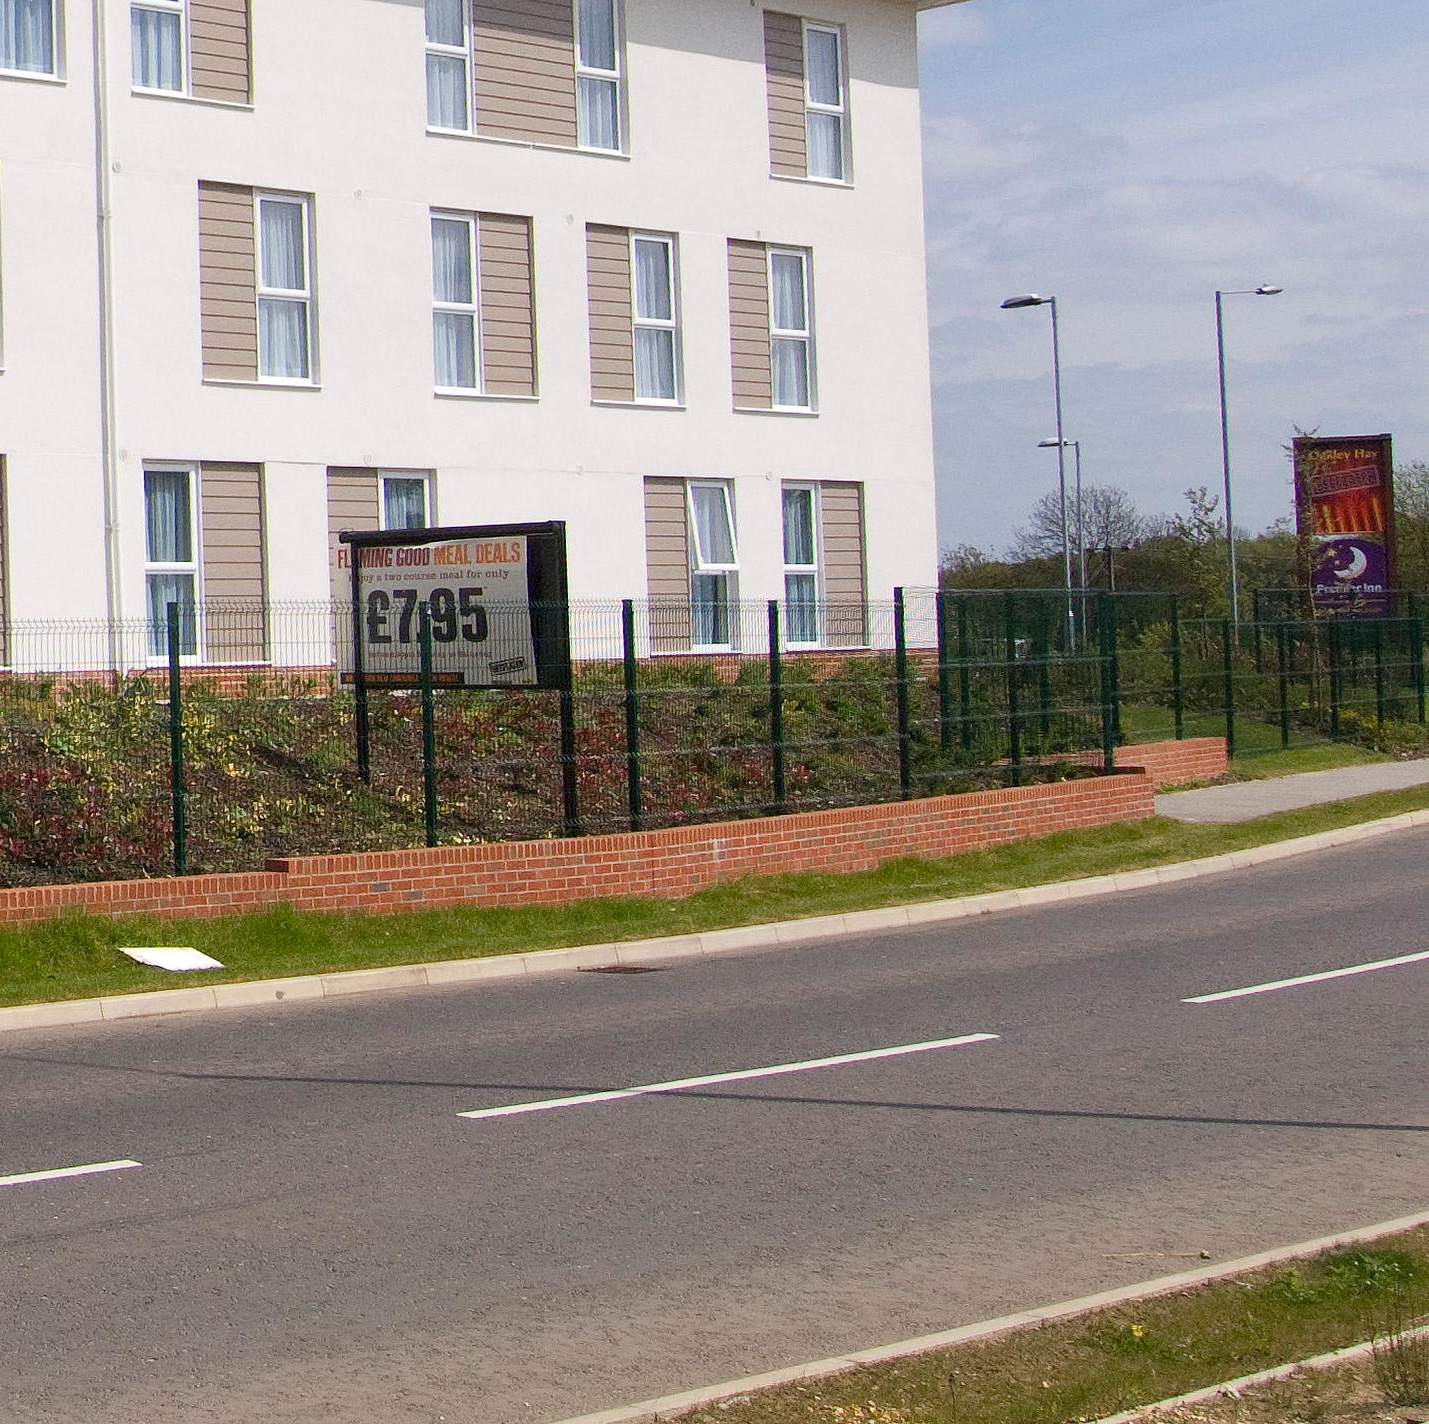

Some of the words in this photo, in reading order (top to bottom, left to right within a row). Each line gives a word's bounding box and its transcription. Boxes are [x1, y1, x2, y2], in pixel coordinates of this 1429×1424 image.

[337, 547, 393, 569] FLMING
[396, 547, 430, 567] GOOD
[433, 544, 470, 566] MEAL
[476, 542, 521, 564] DEALS
[403, 572, 437, 582] course
[439, 569, 463, 580] meal
[466, 569, 482, 579] for
[485, 568, 510, 581] only
